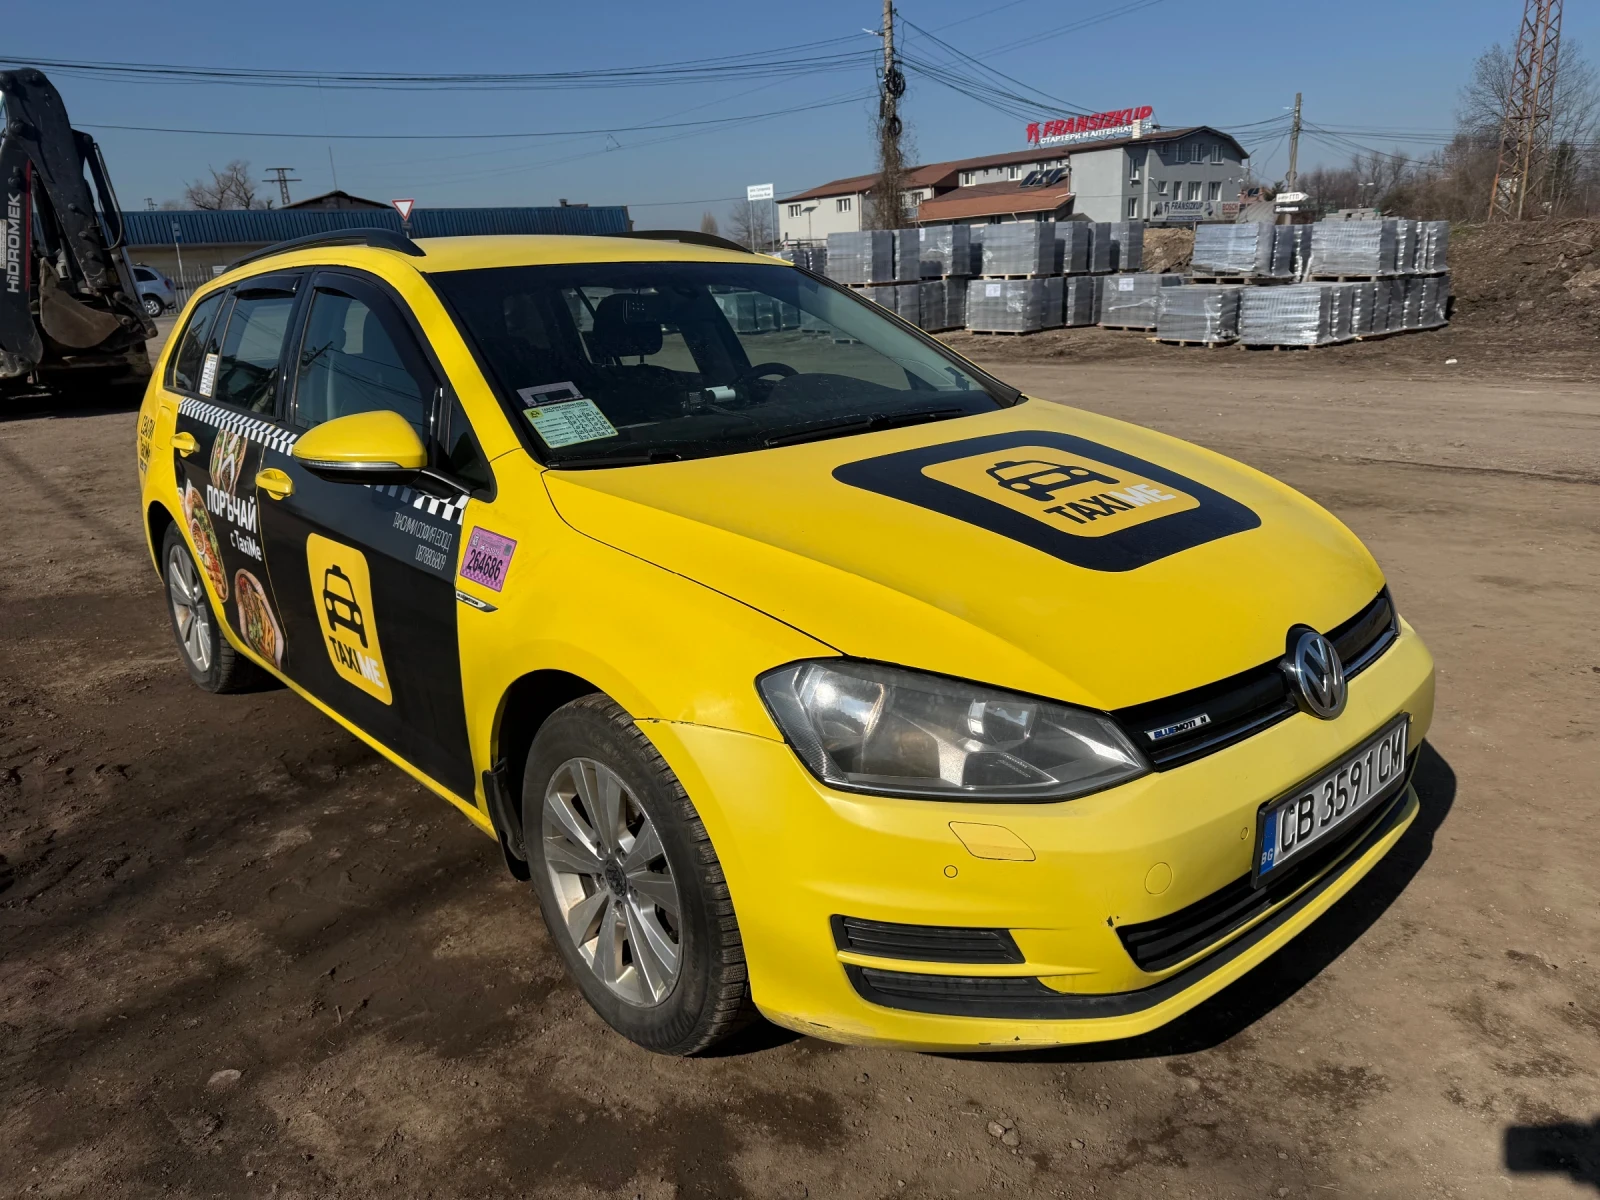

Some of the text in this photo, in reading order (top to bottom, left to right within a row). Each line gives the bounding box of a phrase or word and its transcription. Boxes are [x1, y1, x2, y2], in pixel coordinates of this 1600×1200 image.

[1043, 106, 1153, 137] FRANSIZKUP
[1040, 132, 1081, 144] СТАРТЕРИ
[206, 484, 257, 534] ПОРЪЧАЙ
[234, 530, 262, 561] TaxiMe
[434, 529, 453, 553] ЕООД
[467, 549, 503, 580] 264686
[1279, 723, 1407, 853] CB 3591 CM
[1261, 848, 1274, 866] BG
